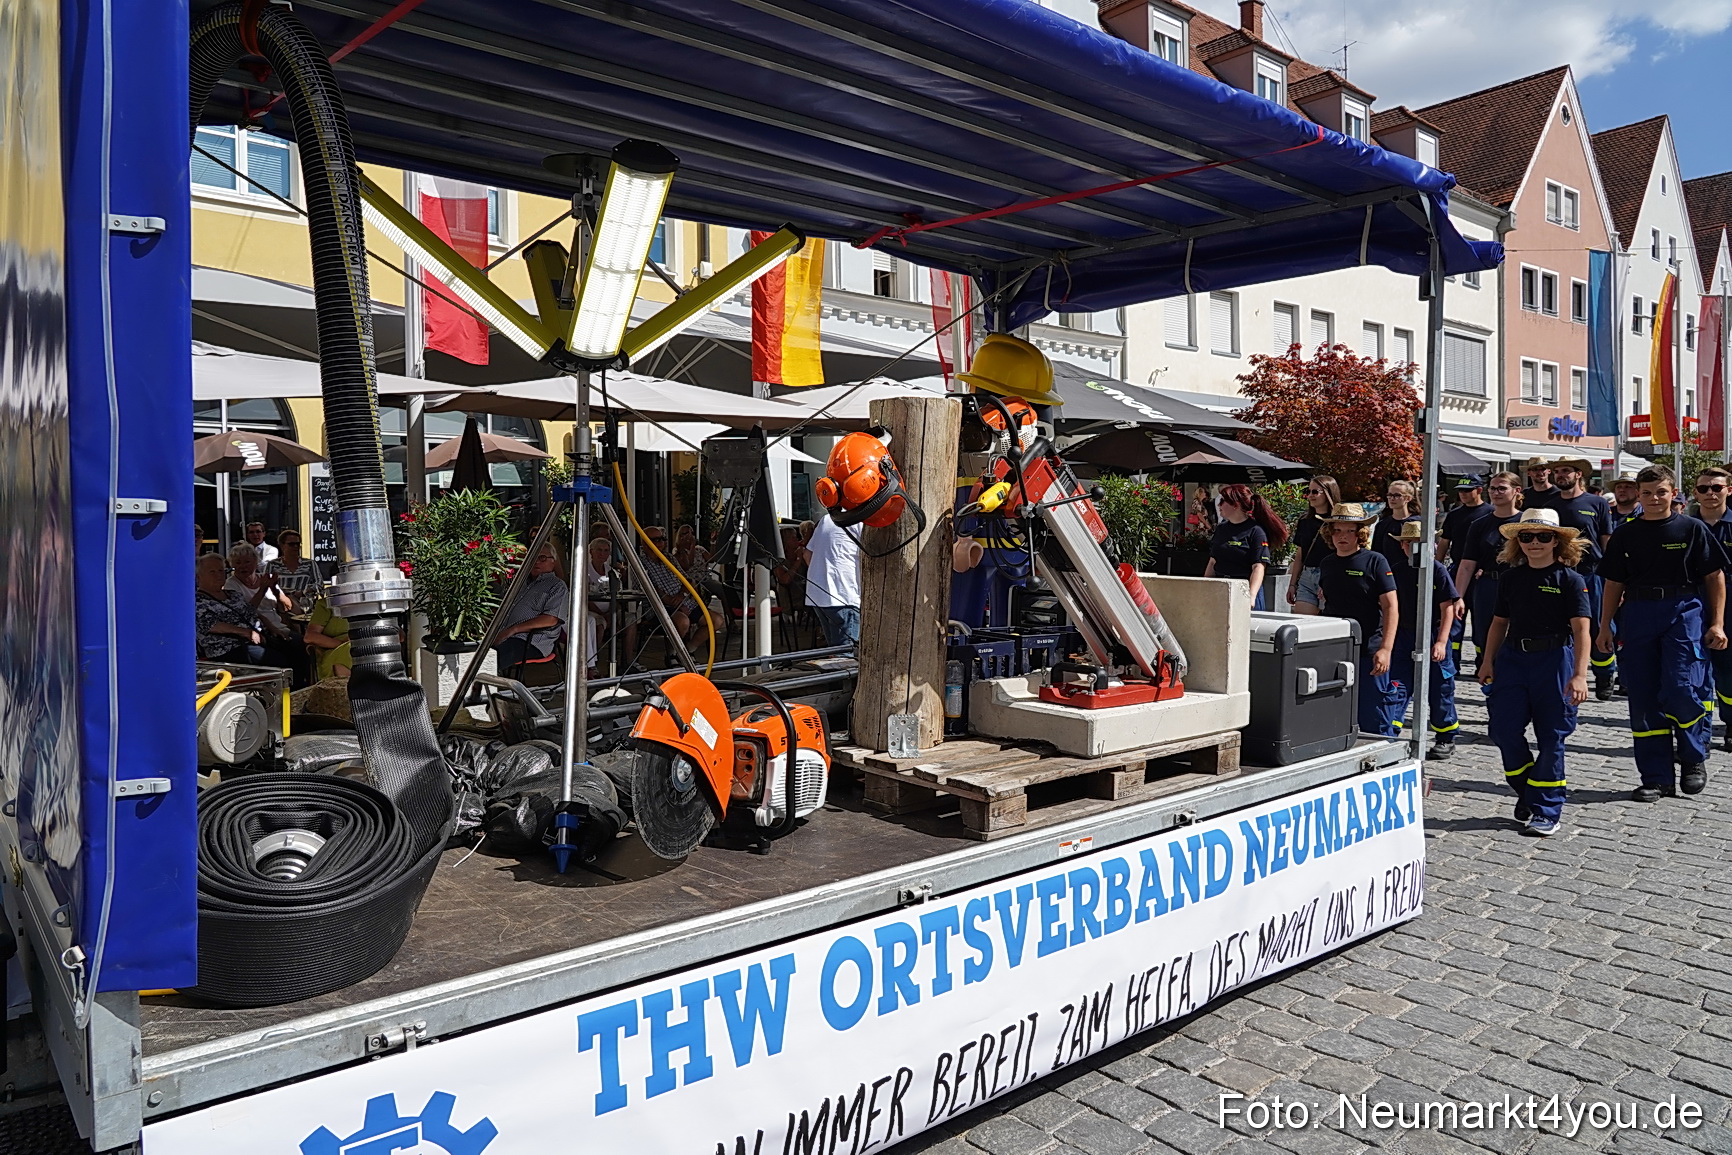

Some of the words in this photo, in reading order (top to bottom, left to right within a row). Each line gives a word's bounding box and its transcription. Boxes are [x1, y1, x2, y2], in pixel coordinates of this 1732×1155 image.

[338, 192, 362, 266] DANCHEM
[237, 441, 268, 467] now
[1151, 433, 1179, 463] now
[577, 953, 797, 1117] THW
[819, 829, 1234, 1031] ORTSVERBAND
[1238, 768, 1418, 887] NEUMARKT
[783, 1066, 913, 1155] IMMER
[926, 1012, 1039, 1126] BEREIT.
[1051, 982, 1114, 1071] ZAM
[1122, 951, 1197, 1040] HELFA,
[1208, 930, 1250, 1001] DES
[1250, 897, 1320, 980] MACHT
[1323, 885, 1358, 947] UNS
[1363, 876, 1375, 933] A
